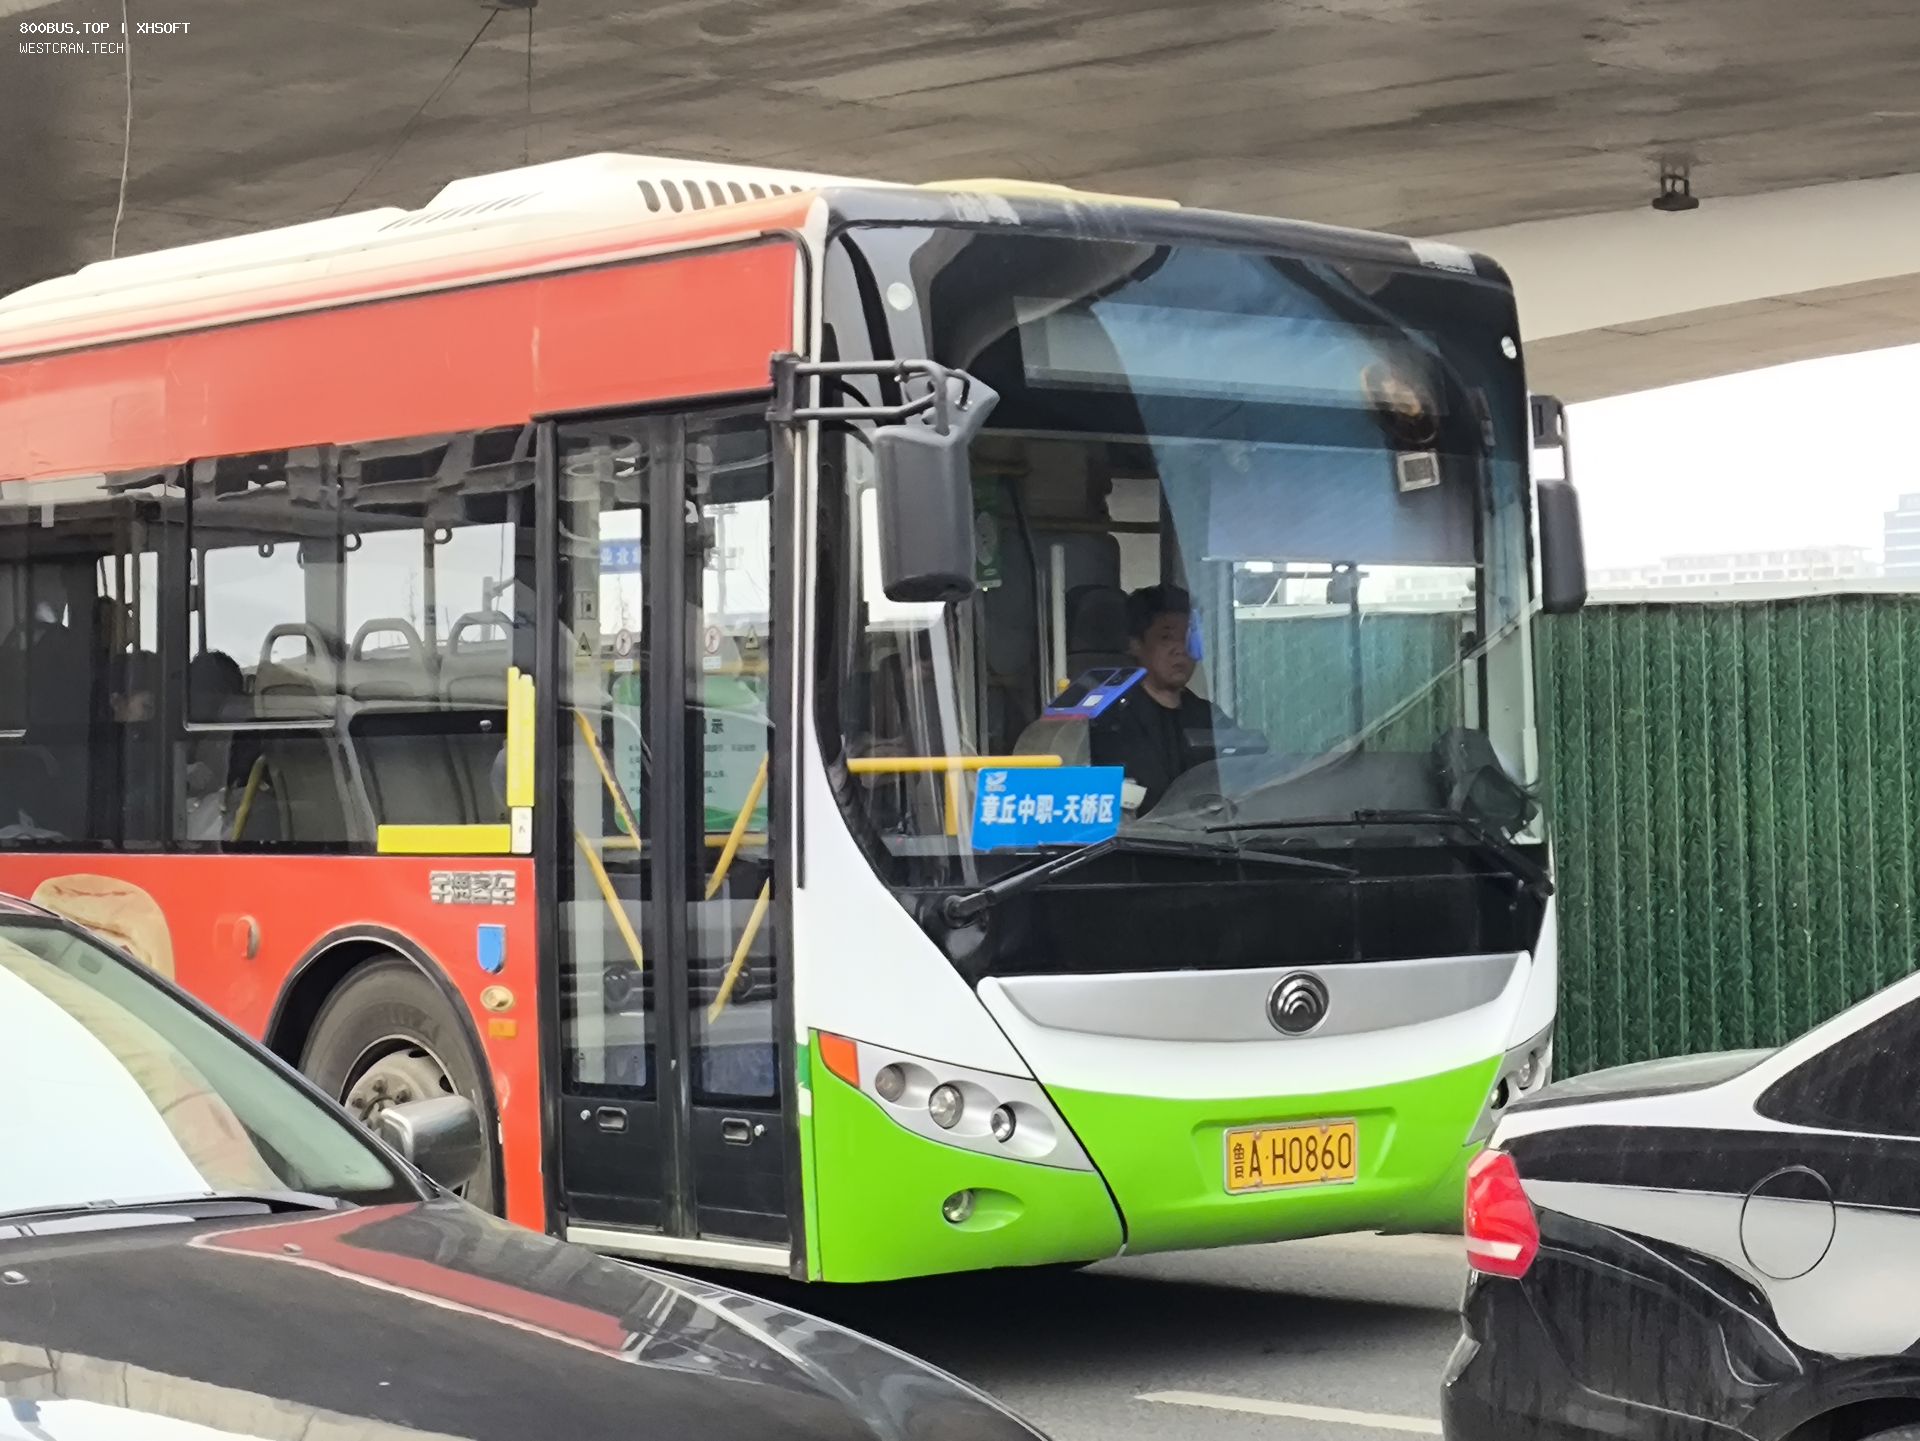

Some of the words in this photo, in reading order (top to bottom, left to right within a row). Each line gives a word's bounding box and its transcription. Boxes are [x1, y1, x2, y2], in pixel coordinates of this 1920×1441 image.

[980, 793, 1116, 825] 章丘中职-天桥区
